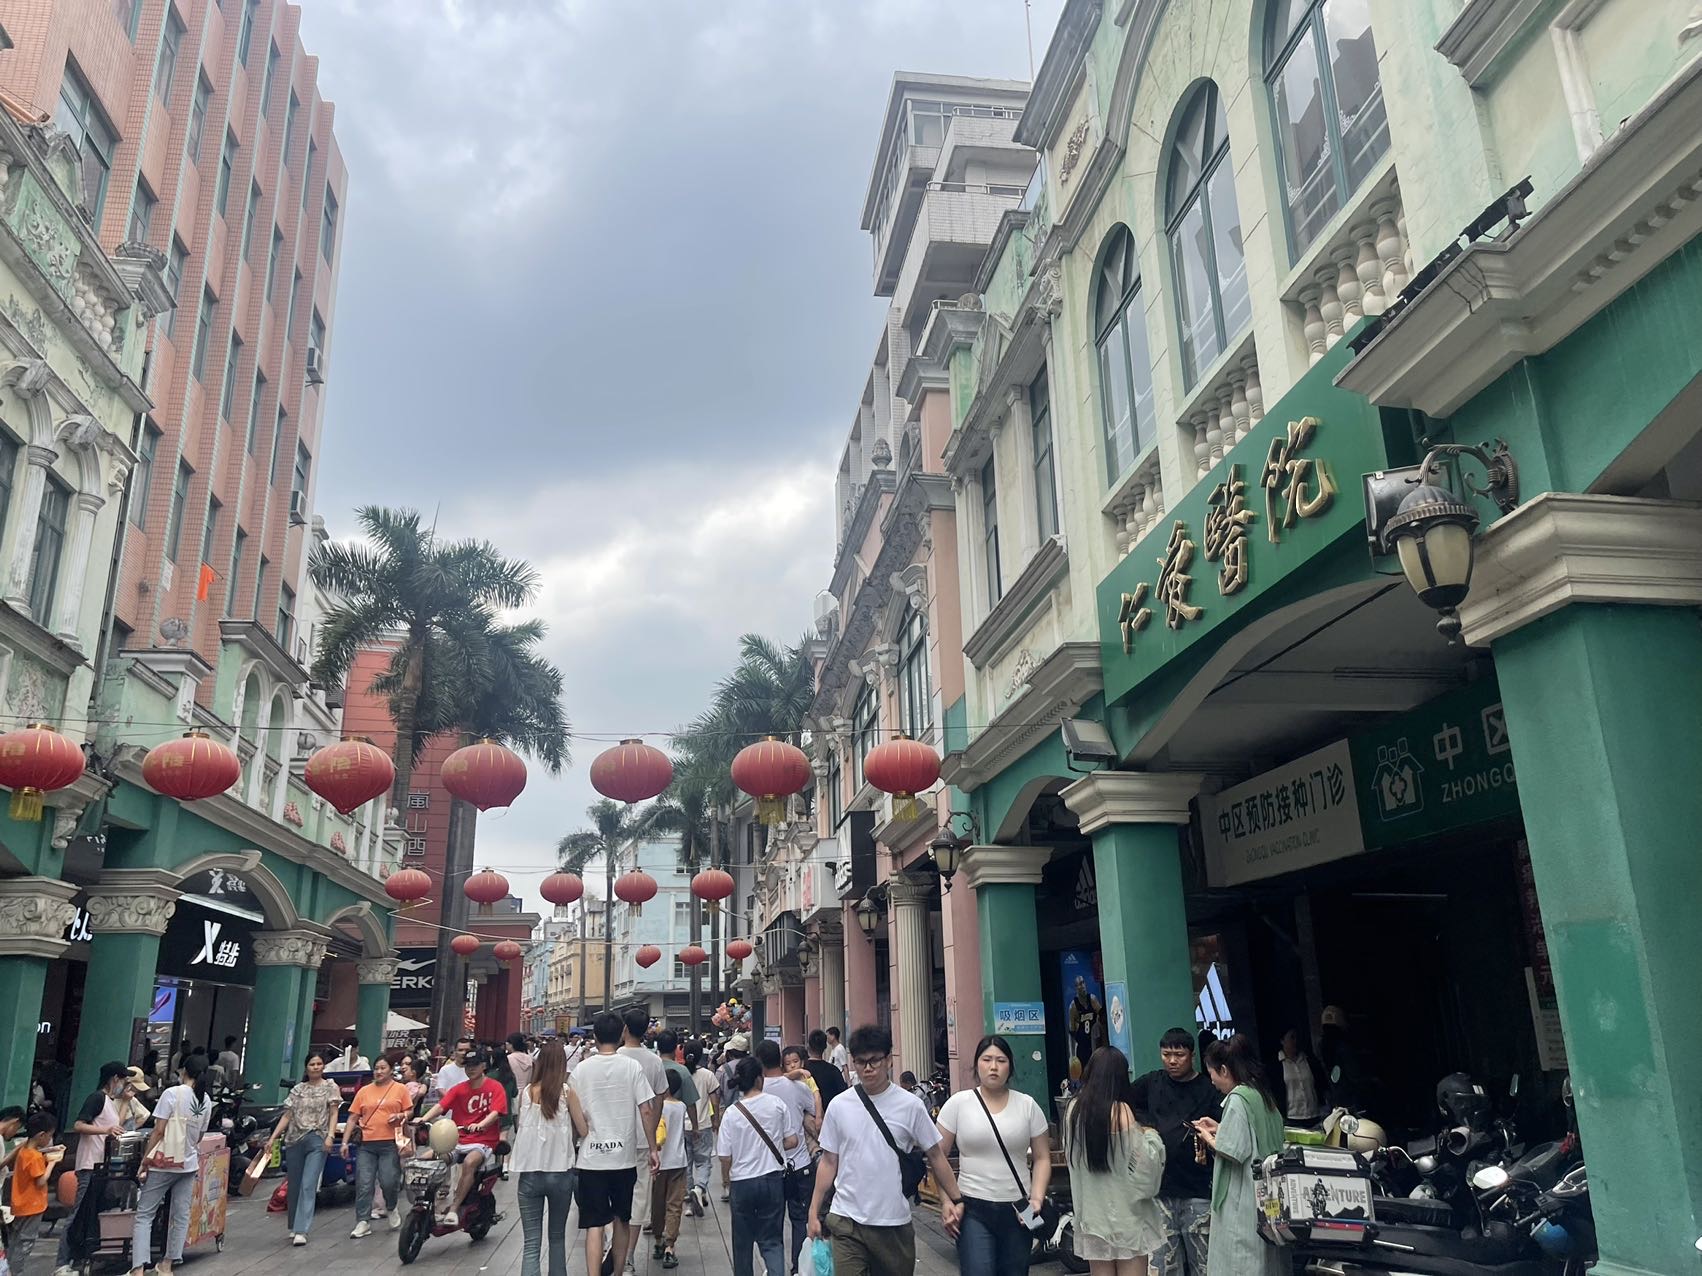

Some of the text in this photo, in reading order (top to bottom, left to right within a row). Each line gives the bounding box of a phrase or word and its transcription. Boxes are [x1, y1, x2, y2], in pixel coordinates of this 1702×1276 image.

[1219, 763, 1345, 843] 中区预防接种门诊
[404, 789, 430, 868] 嵐山酒
[390, 976, 434, 989] ERK
[999, 1009, 1040, 1022] 吸烟区
[589, 1141, 624, 1150] PRADA
[1303, 1182, 1367, 1206] AENTURE
